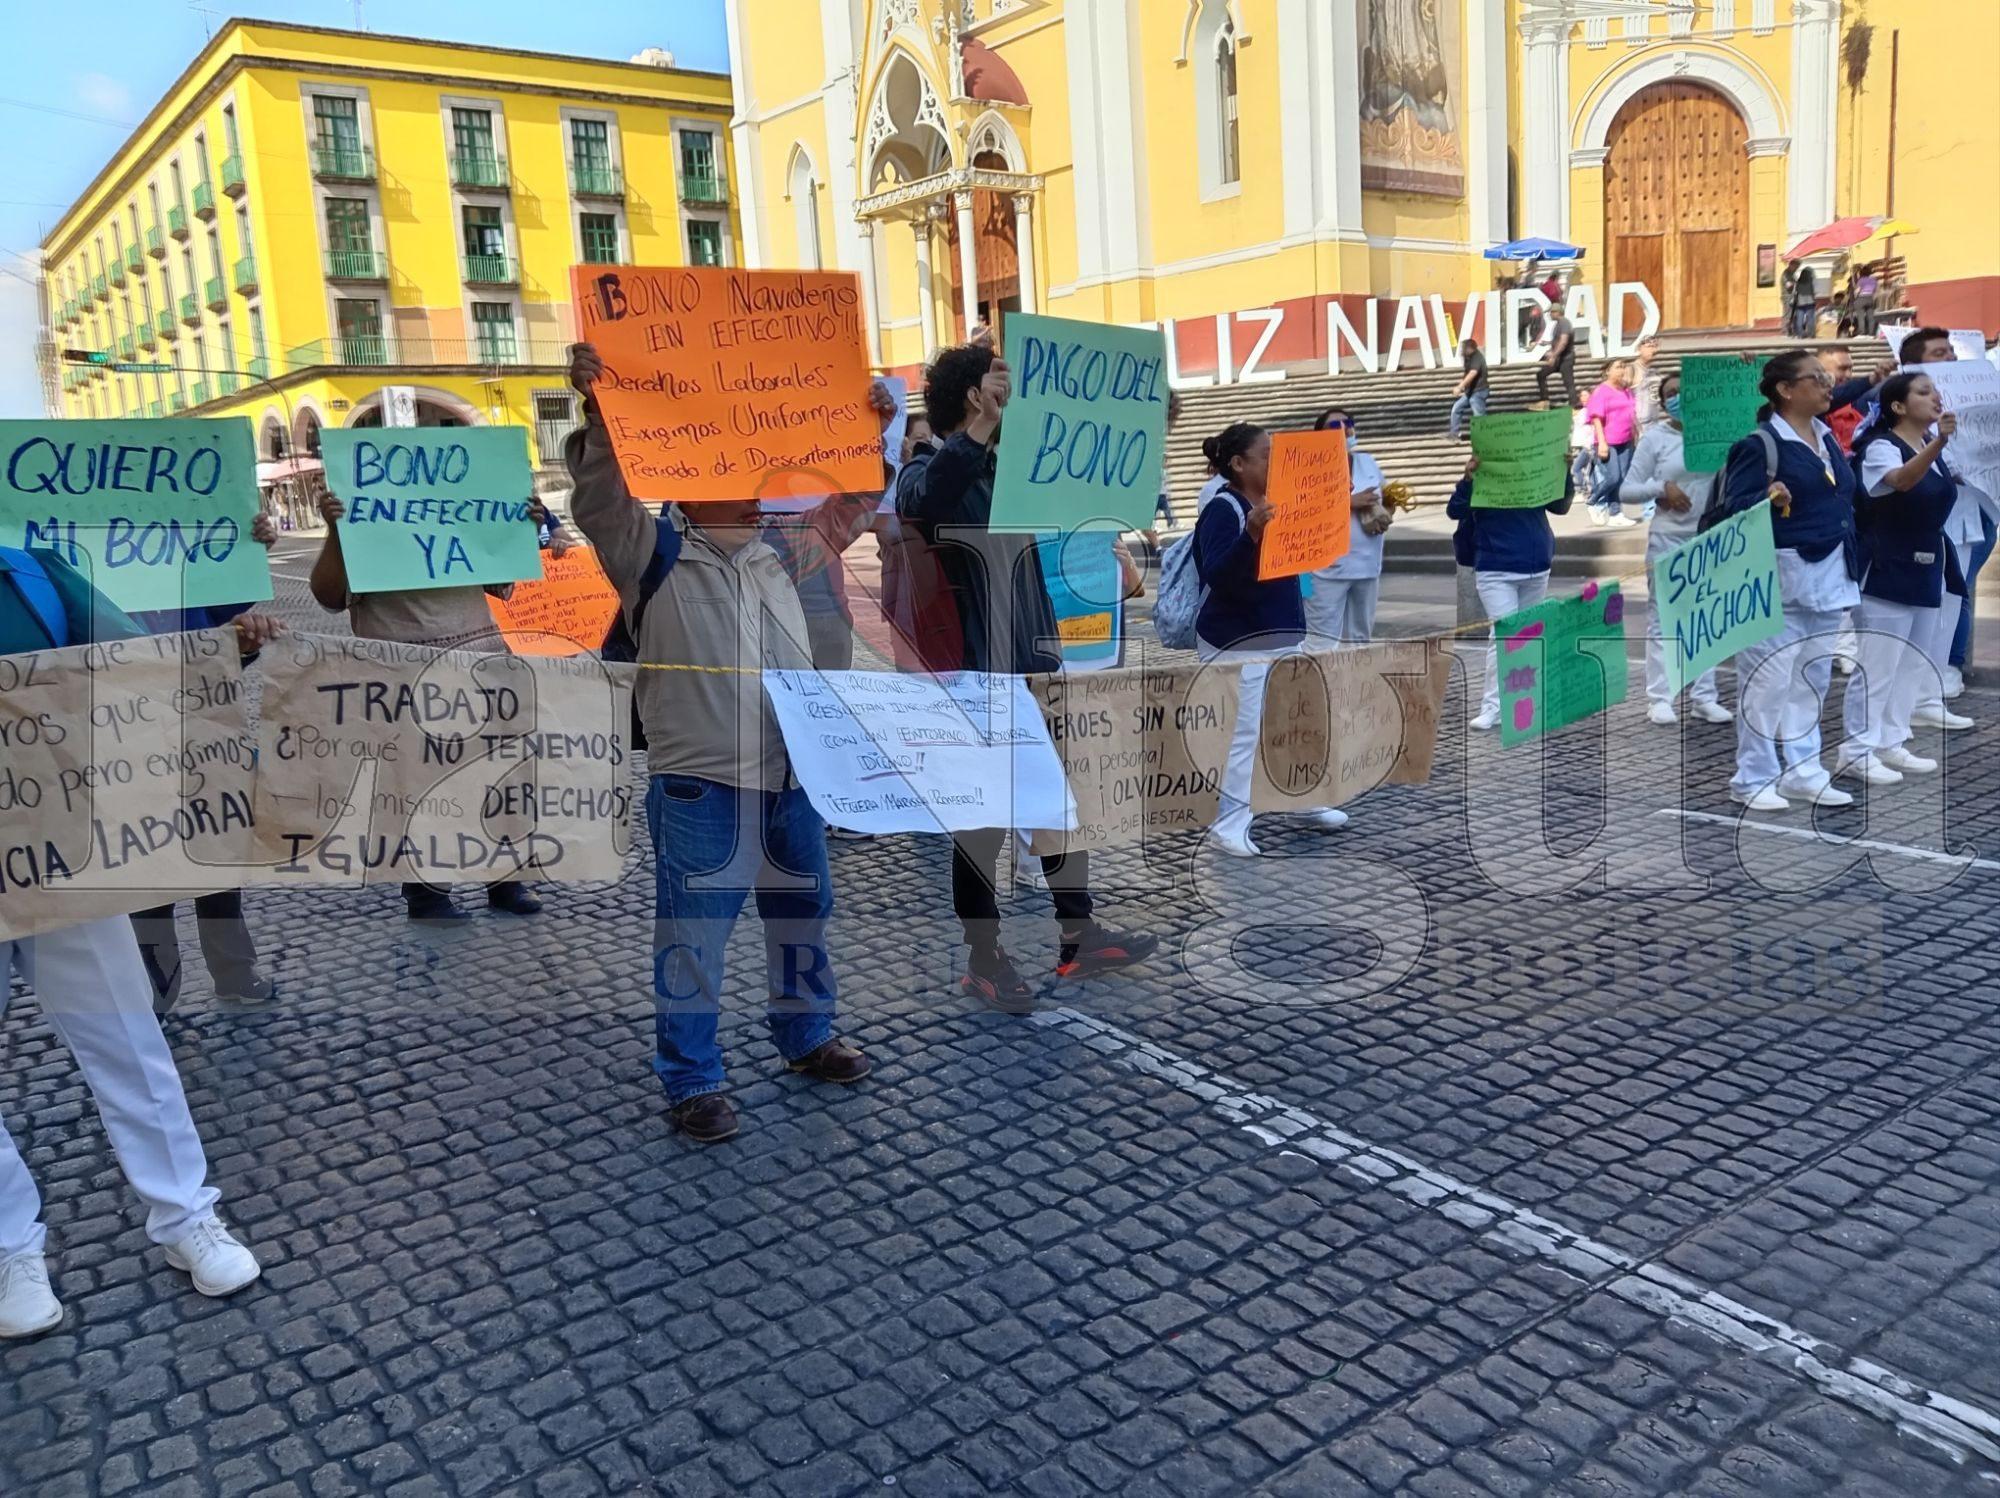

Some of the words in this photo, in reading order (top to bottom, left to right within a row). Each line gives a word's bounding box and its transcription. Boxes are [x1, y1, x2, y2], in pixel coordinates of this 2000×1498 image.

[648, 321, 684, 353] EN
[1326, 281, 1661, 376] NAVIDAD
[1019, 336, 1107, 402] PAGO
[1109, 352, 1162, 404] DEL
[7, 437, 222, 496] QUIERO
[354, 441, 469, 490] BONO
[711, 452, 738, 475] de
[1028, 411, 1147, 488] BONO
[349, 496, 396, 524] EN
[401, 497, 532, 526] EFECTIVO
[24, 516, 79, 567] MI
[105, 516, 239, 569] BONO
[412, 533, 474, 580] YA
[1669, 515, 1748, 605] SOMOS
[1694, 577, 1719, 604] EL
[1675, 567, 1774, 670] NACHÓN
[84, 639, 133, 672] de
[154, 630, 220, 663] mis
[90, 695, 156, 744] que
[317, 681, 520, 726] TRABAJO
[1132, 705, 1165, 736] SIN
[1174, 694, 1226, 732] CAPA!
[422, 732, 465, 766] NO
[480, 732, 623, 767] TENEMOS
[1099, 741, 1165, 783] personal
[59, 758, 132, 812] pero
[147, 733, 257, 799] exigimos
[1286, 763, 1333, 789] IMSS
[314, 783, 356, 820] los
[374, 790, 465, 819] mismos
[483, 783, 634, 828] DERECHOS?
[274, 832, 565, 876] IGUALDAD
